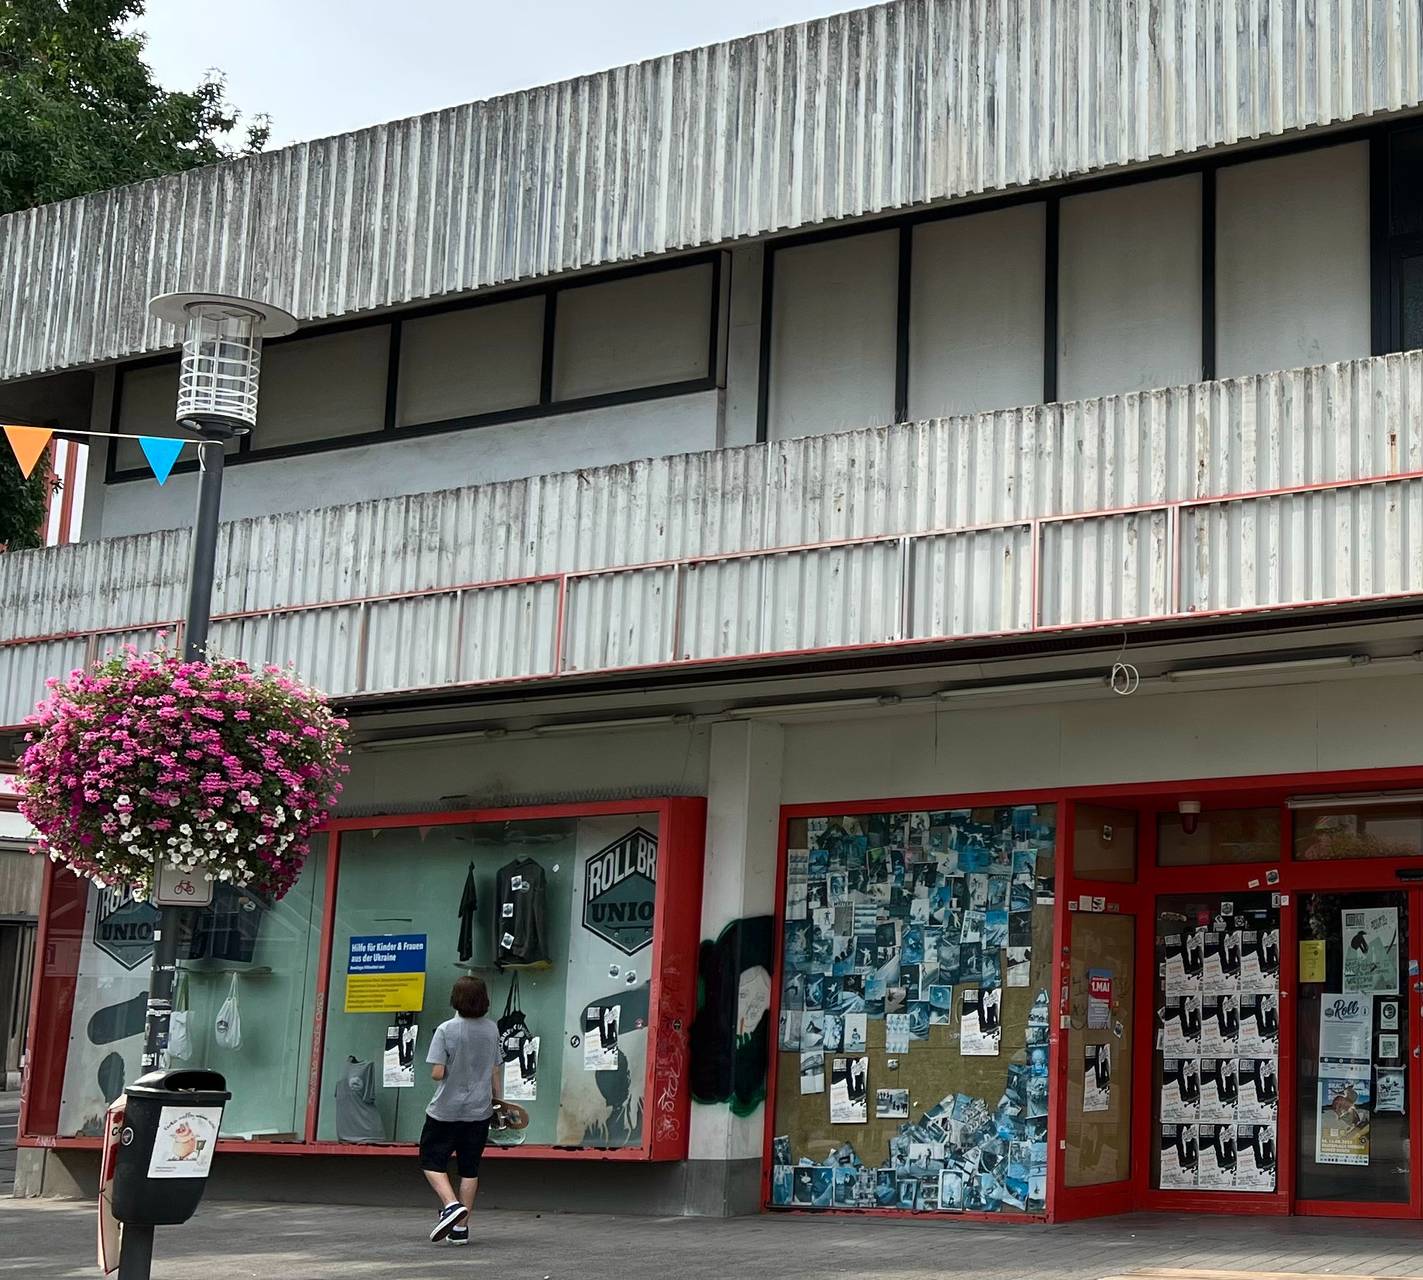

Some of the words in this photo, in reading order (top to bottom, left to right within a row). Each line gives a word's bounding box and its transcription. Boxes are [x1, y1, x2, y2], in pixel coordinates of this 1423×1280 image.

[589, 841, 635, 901] ROLL
[637, 837, 656, 880] BR
[591, 901, 654, 923] UNIO
[102, 922, 154, 941] UNIO
[351, 943, 366, 952] Hilfe
[367, 942, 376, 952] für
[377, 941, 397, 951] Kinder
[403, 941, 424, 951] Frauen
[362, 953, 373, 962] der
[373, 952, 397, 961] Ukraine
